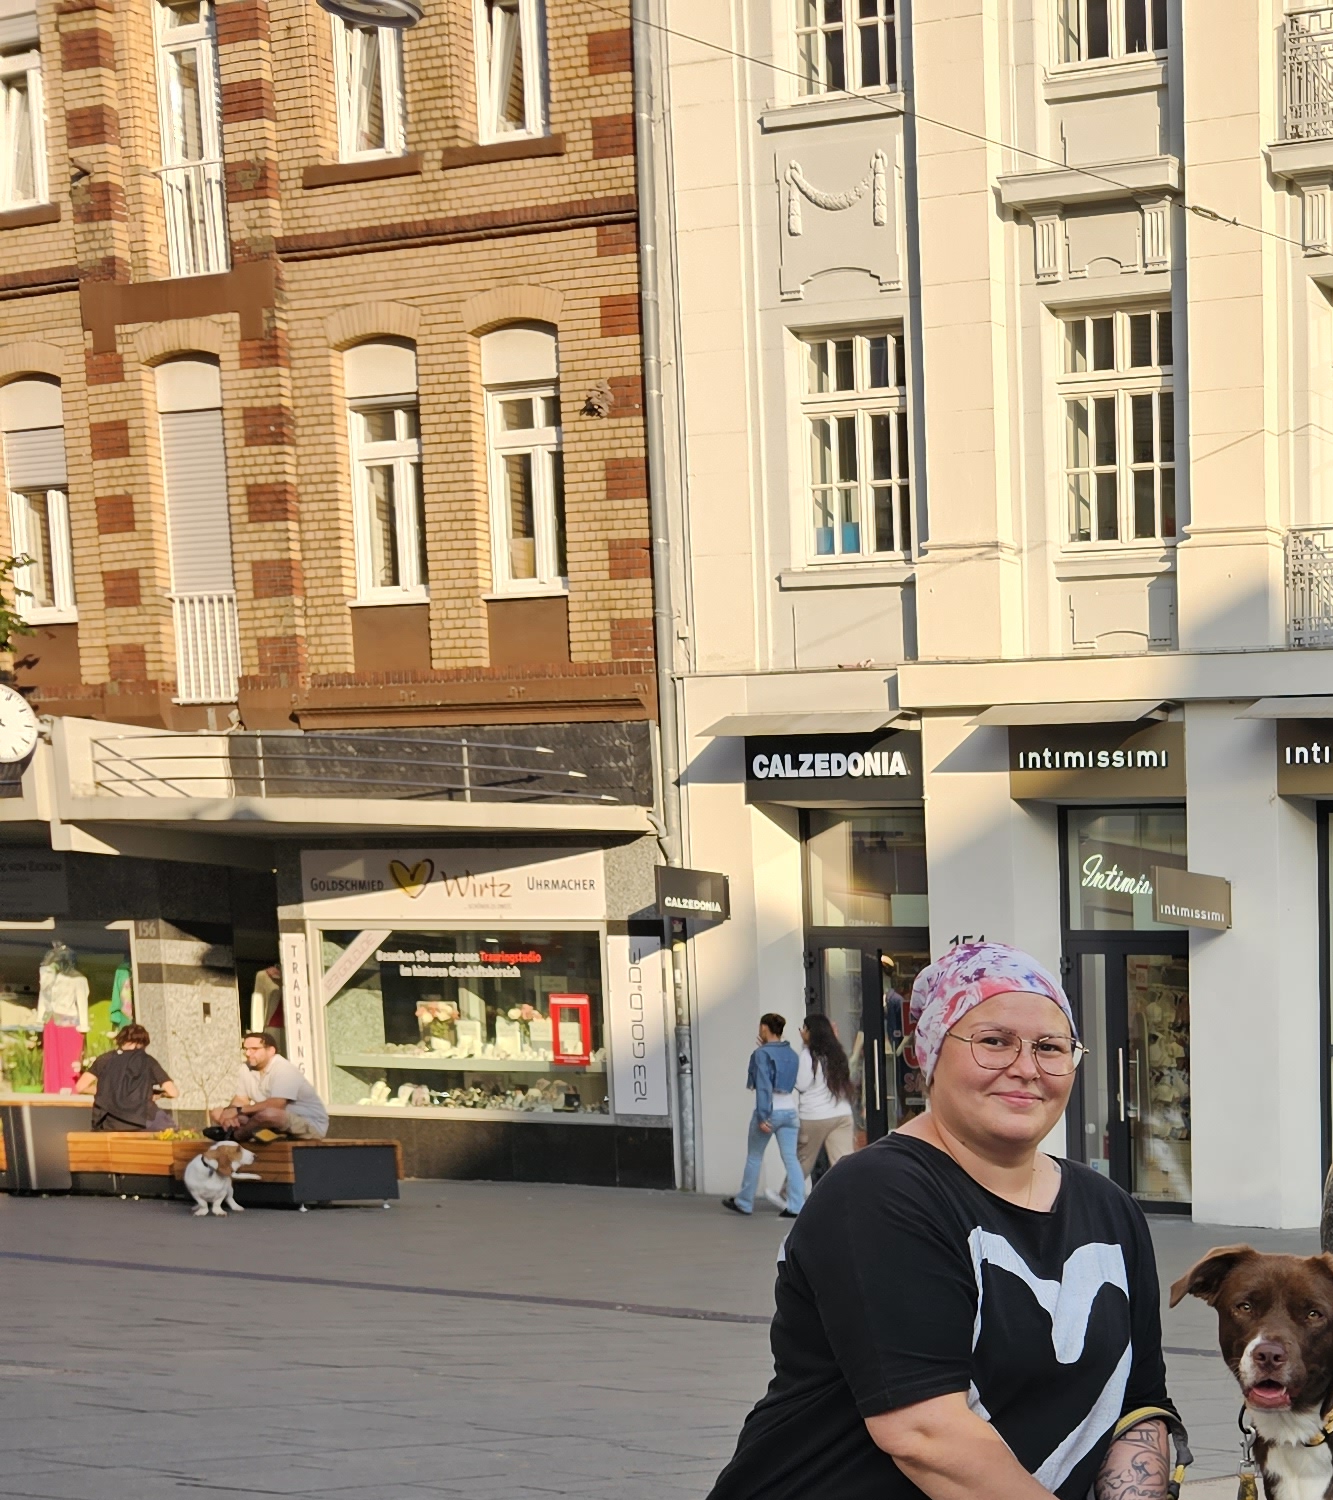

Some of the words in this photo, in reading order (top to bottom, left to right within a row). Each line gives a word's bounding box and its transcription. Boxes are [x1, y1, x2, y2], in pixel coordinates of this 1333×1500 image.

[752, 750, 909, 779] CALZEDONIA
[1018, 747, 1168, 769] intimissimi
[440, 869, 512, 898] Wirtz
[664, 896, 722, 912] CALZEDONIA
[1160, 903, 1225, 922] intimissimi
[138, 921, 157, 937] 156
